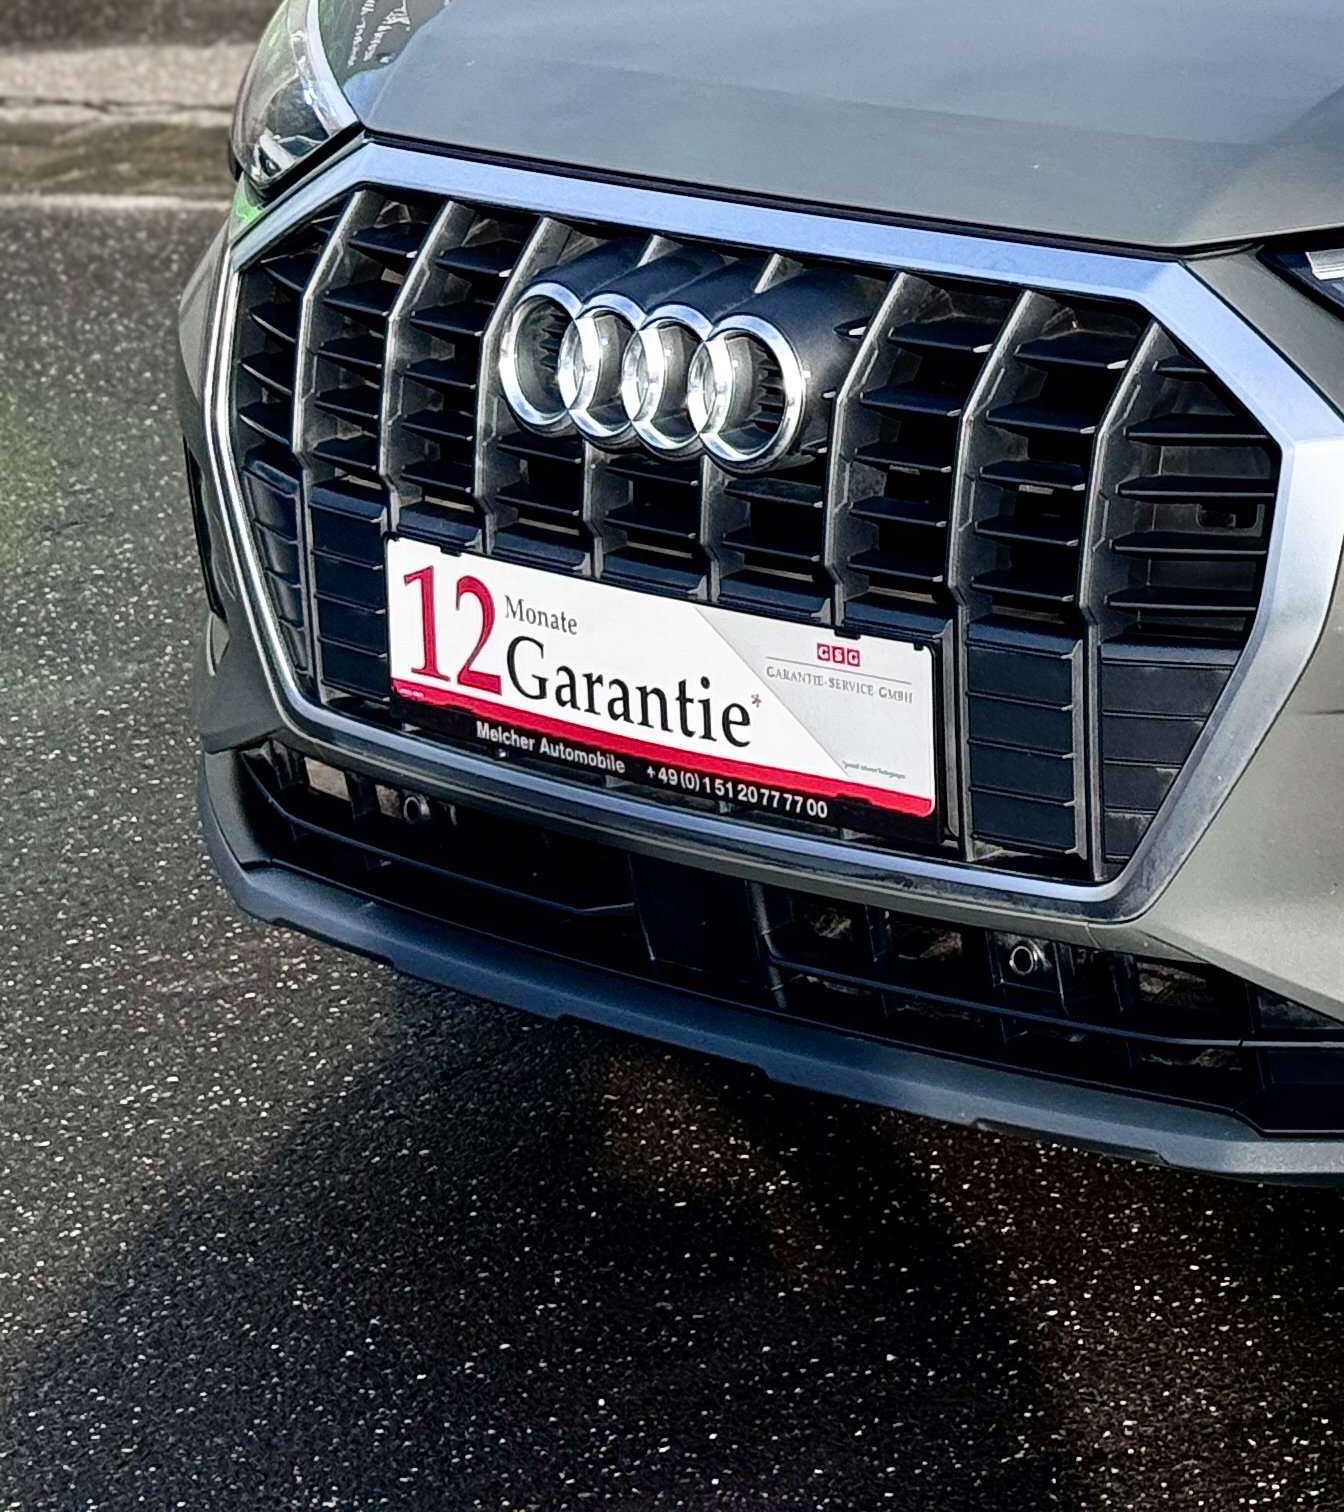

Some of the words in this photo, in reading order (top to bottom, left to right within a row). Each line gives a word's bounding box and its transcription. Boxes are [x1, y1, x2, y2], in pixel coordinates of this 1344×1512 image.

[403, 565, 503, 696] 12
[504, 595, 579, 635] Monate
[475, 720, 536, 751] Melcher
[539, 736, 627, 774] Automobile
